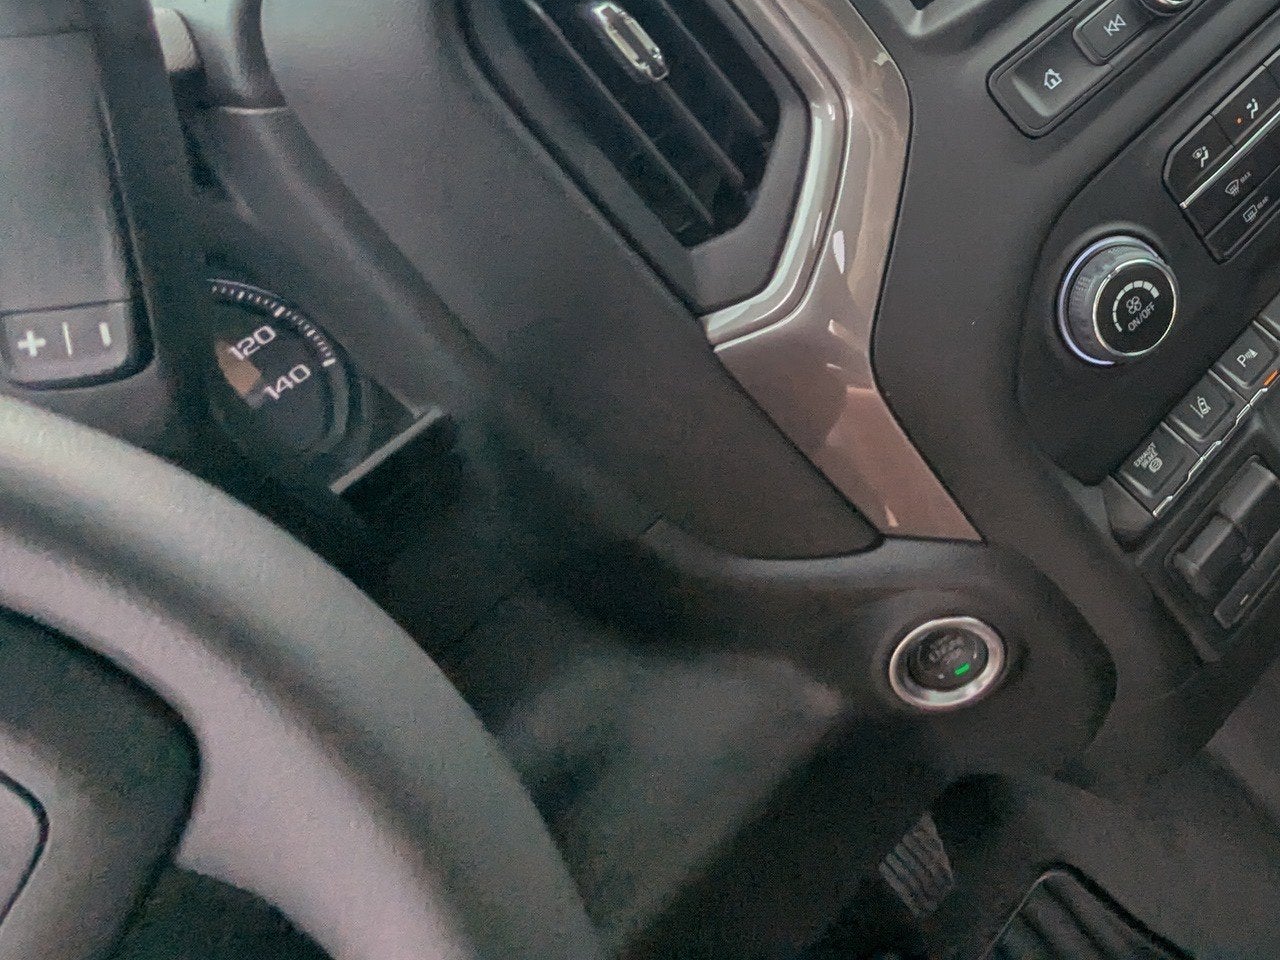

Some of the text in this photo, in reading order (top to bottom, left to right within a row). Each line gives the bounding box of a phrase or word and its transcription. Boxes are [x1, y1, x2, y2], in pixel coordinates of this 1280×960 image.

[1127, 301, 1156, 331] ON/OFF
[228, 324, 278, 362] 120
[263, 364, 312, 401] 140
